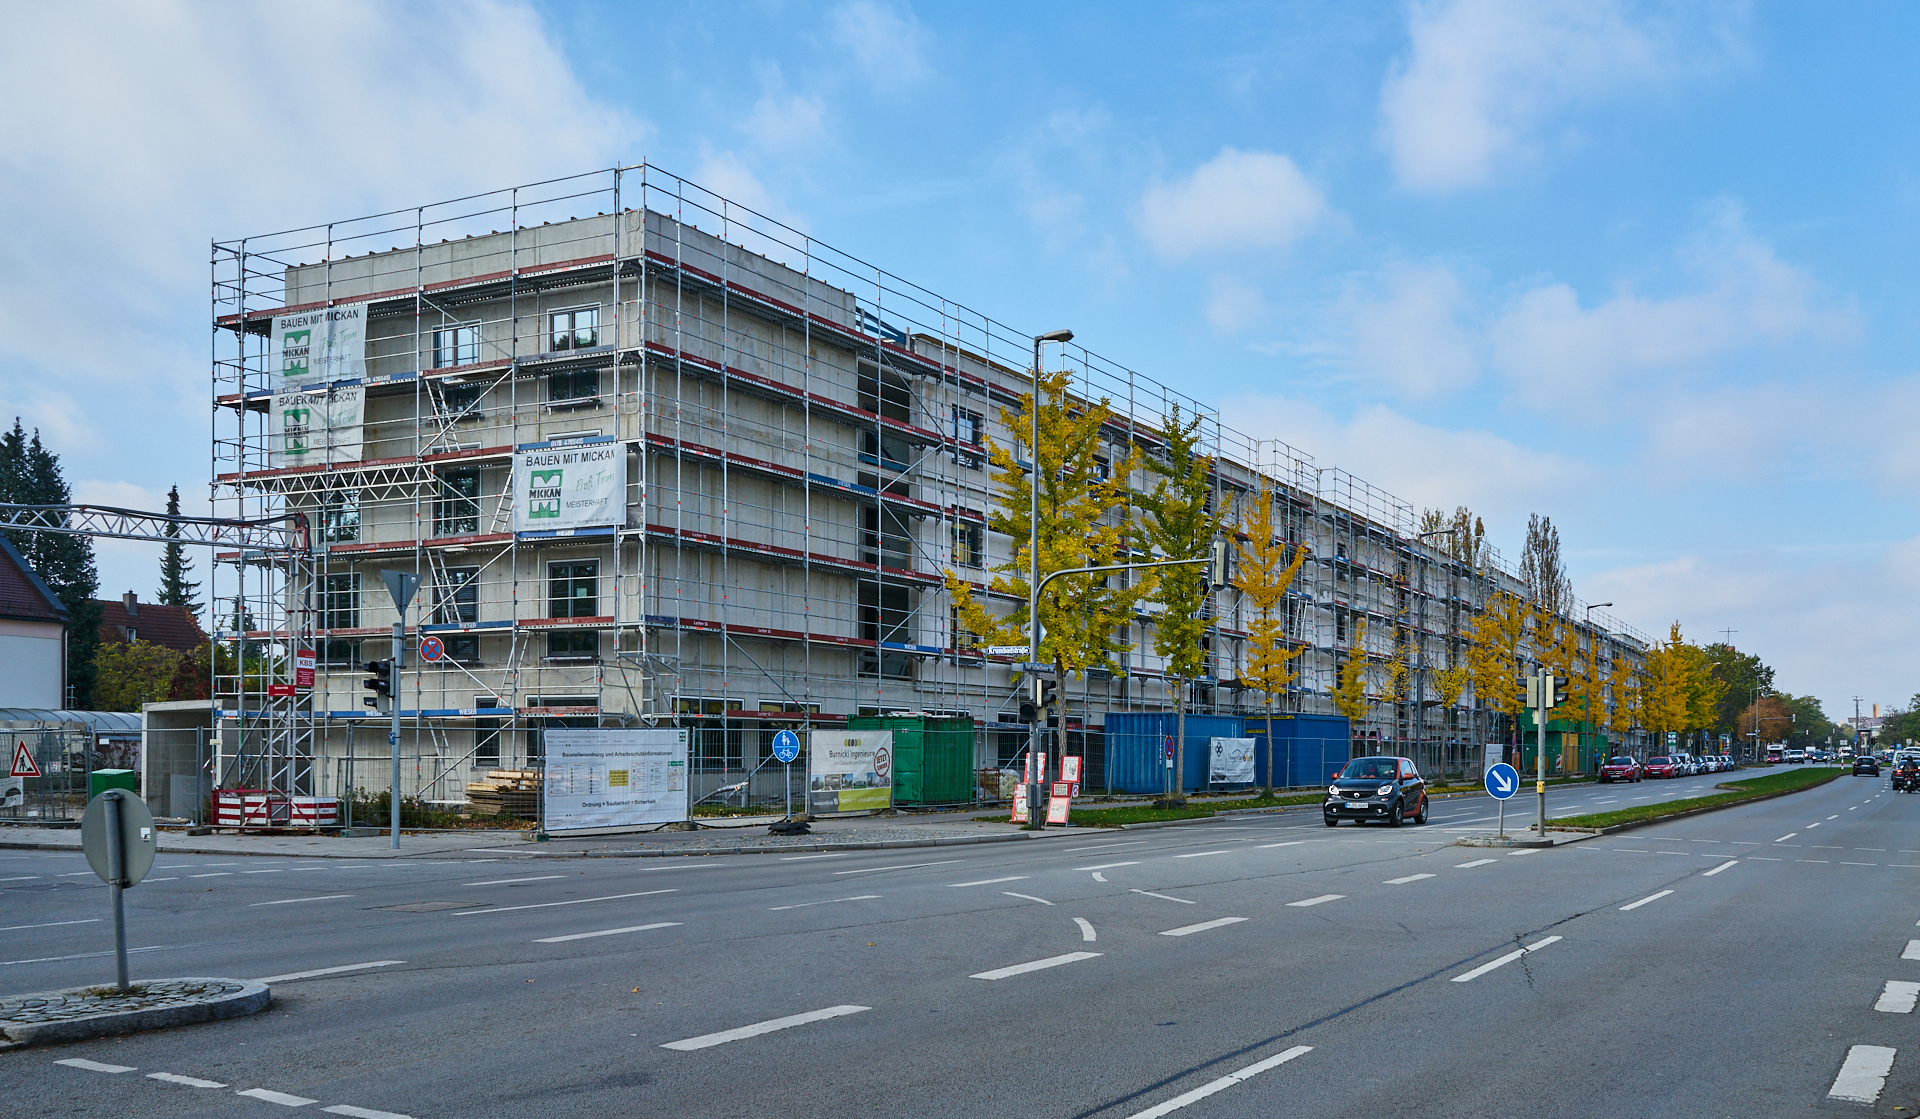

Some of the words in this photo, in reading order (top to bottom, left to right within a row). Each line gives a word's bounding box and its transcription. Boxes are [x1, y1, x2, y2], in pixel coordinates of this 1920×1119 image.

[281, 317, 309, 330] BAUEN
[310, 314, 324, 325] MIT
[325, 309, 359, 321] MICKAN
[283, 347, 310, 358] MICKAN
[313, 353, 351, 365] MEISTERHAFT
[308, 395, 324, 406] MIT
[313, 436, 351, 446] MEISERHAFT
[526, 455, 560, 467] BAUEN
[562, 453, 579, 464] MIT
[581, 449, 615, 463] MICKAN
[576, 474, 593, 492] Profi
[596, 469, 615, 486] Team
[529, 488, 562, 499] MICKAN
[566, 497, 609, 509] MEISTERHAFT
[988, 646, 1029, 655] Krumbadstraße
[829, 750, 850, 758] Burnickl
[850, 749, 876, 760] Ingenieure
[876, 754, 887, 764] JETZT
